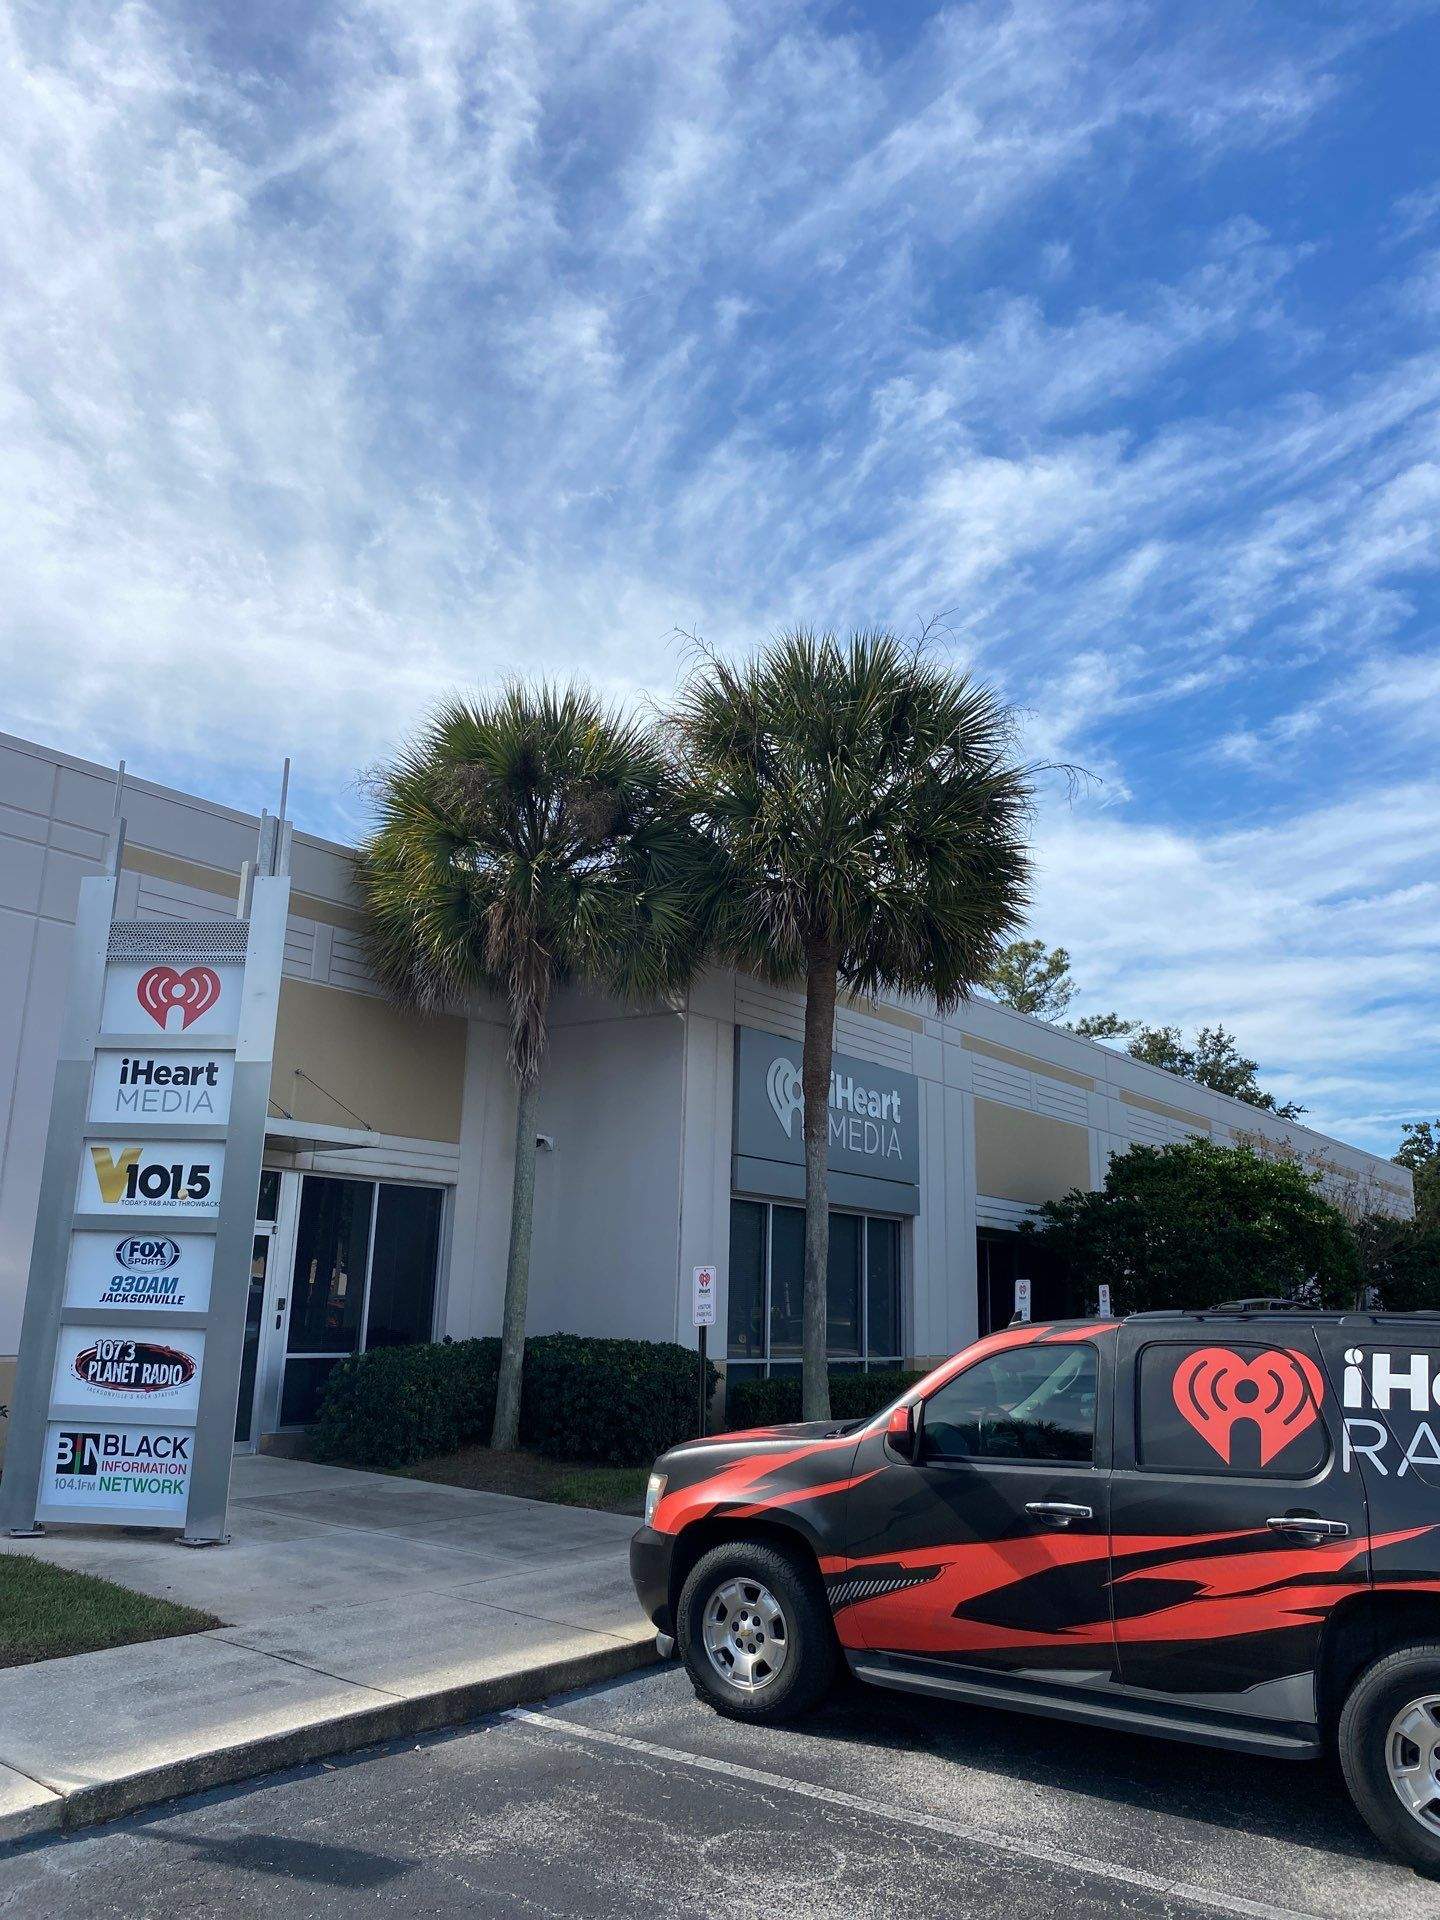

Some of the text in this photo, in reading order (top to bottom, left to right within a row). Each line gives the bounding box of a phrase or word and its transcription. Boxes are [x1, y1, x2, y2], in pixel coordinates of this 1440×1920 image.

[119, 1058, 219, 1086] iHeart
[115, 1088, 214, 1114] MEDIA
[828, 1113, 903, 1160] MEDIA
[129, 1241, 168, 1258] FOX
[128, 1258, 166, 1266] SPORTS
[109, 1275, 179, 1294] 930AM
[99, 1293, 185, 1305] JACKSONVILLE
[87, 1361, 182, 1386] PLANET RADIO
[102, 1434, 190, 1459] BLACK
[101, 1460, 187, 1475] INFORMATION
[98, 1476, 185, 1495] NETWORK
